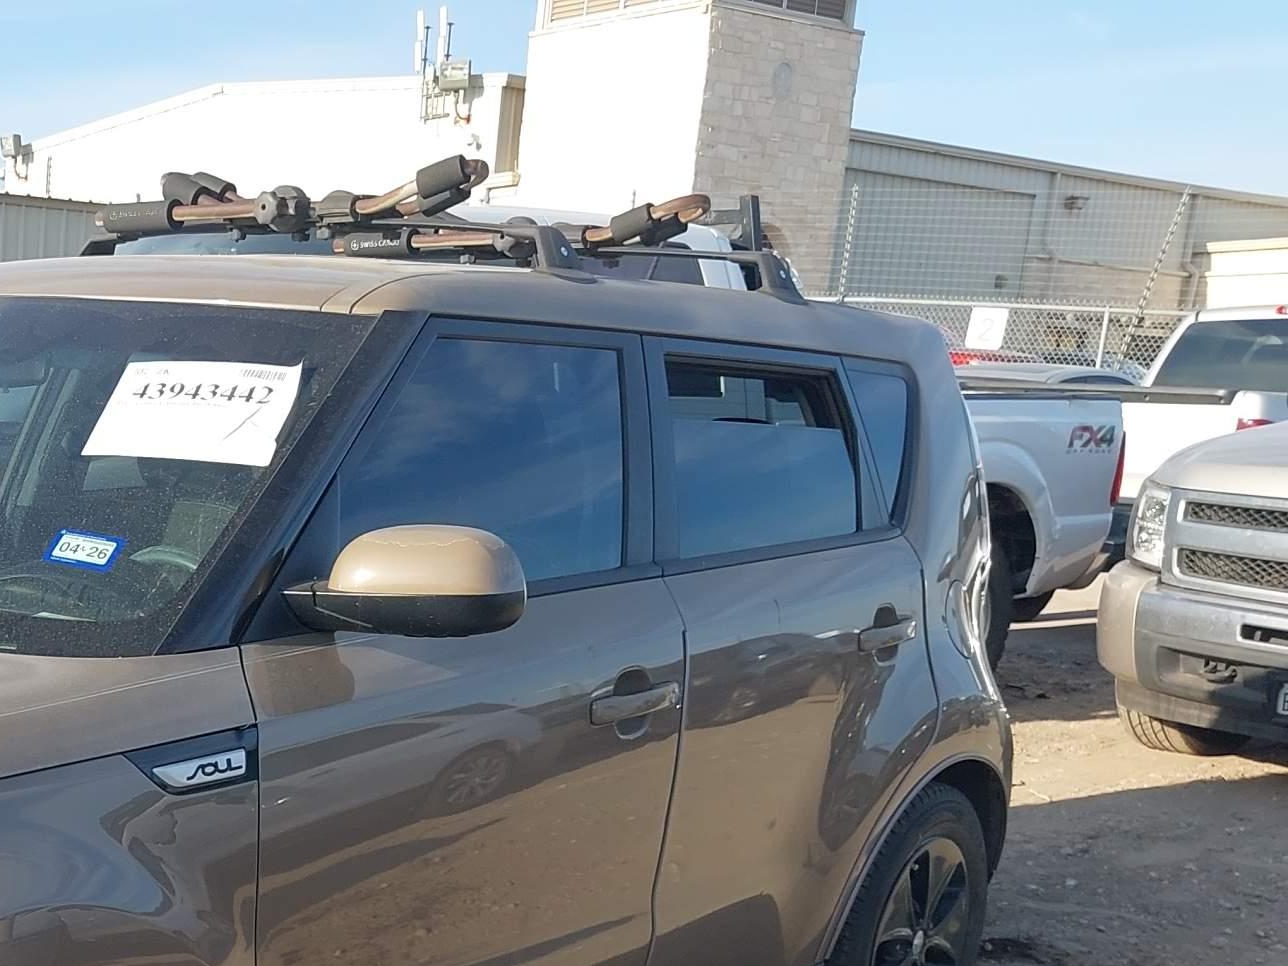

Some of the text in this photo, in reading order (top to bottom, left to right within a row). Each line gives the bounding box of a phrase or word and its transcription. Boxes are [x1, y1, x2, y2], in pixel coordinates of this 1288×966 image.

[132, 382, 275, 405] 43943442
[1067, 425, 1115, 448] FX4
[59, 541, 110, 559] 04 26
[186, 758, 243, 781] SOUL
